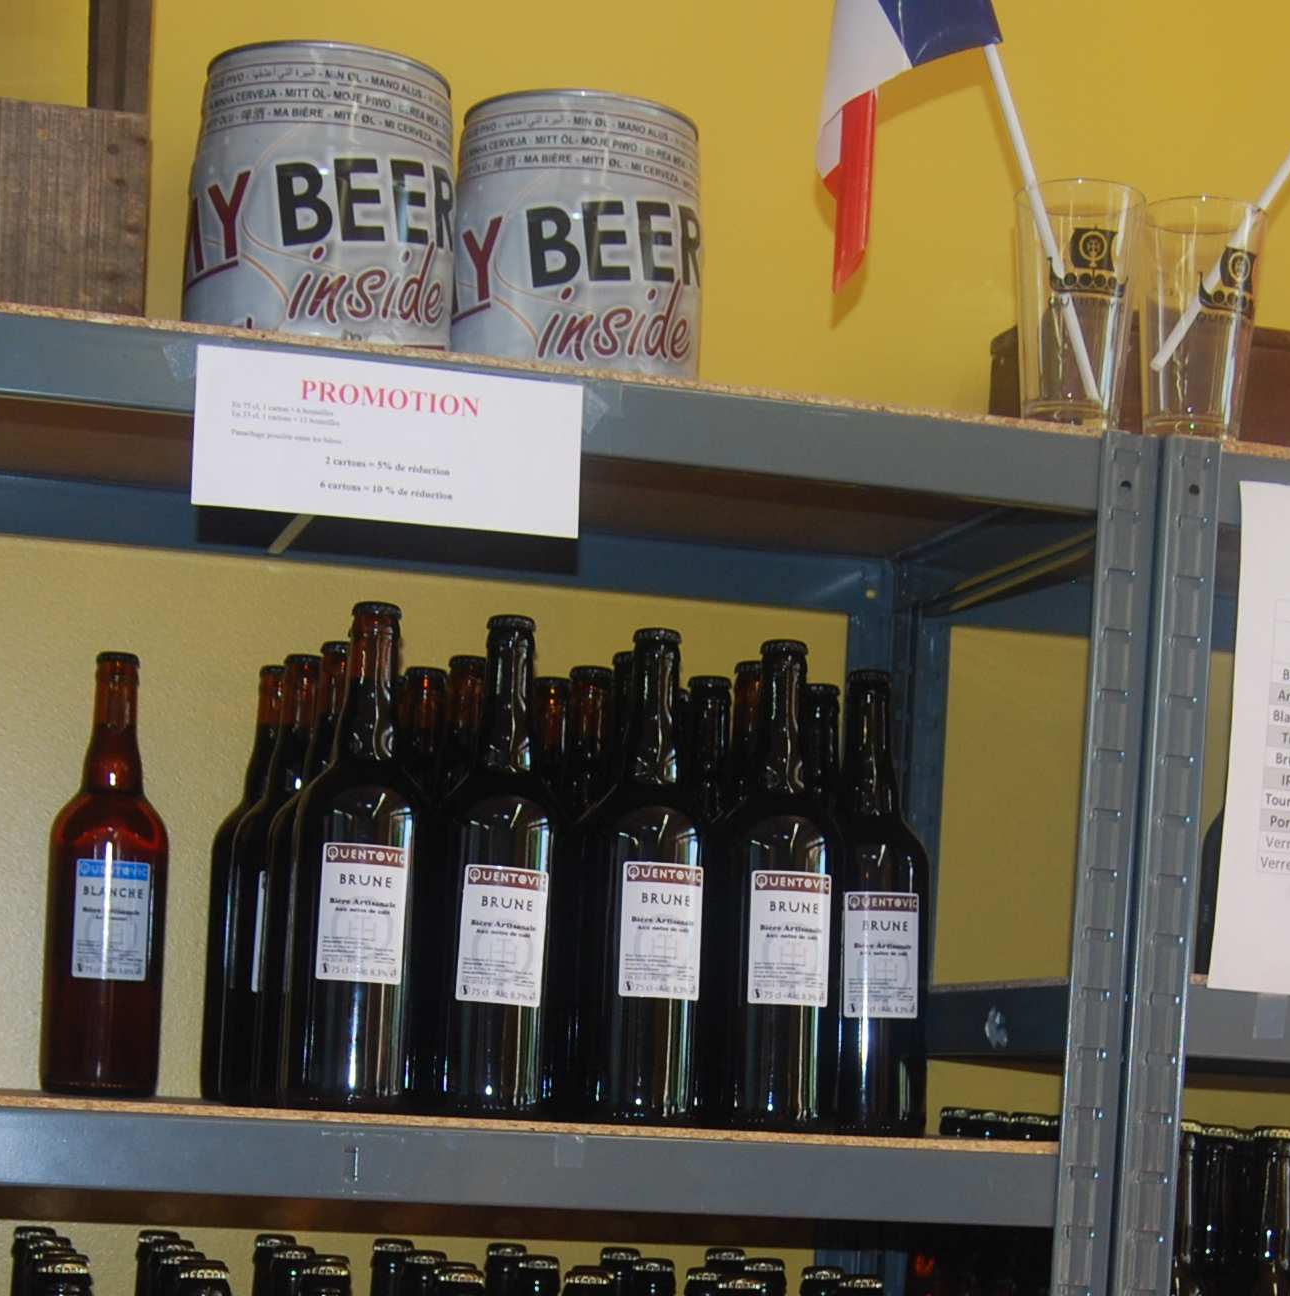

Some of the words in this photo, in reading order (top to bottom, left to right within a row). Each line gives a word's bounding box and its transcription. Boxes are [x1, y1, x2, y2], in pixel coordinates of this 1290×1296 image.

[524, 155, 539, 164] MA
[276, 158, 454, 251] BEER
[526, 200, 701, 288] BEER
[287, 242, 445, 324] inside
[537, 278, 690, 361] inside
[301, 380, 481, 417] PROMOTION
[325, 456, 331, 465] 2
[333, 458, 366, 469] cartons
[377, 461, 392, 471] 5%
[395, 463, 405, 472] de
[408, 463, 450, 476] réduction
[319, 480, 325, 489] 6
[327, 482, 361, 492] cartons
[372, 485, 383, 494] 10
[397, 488, 408, 497] de
[410, 488, 453, 501] réduction
[327, 846, 406, 864] QUENTOVIC
[339, 874, 392, 888] BRUNE
[627, 864, 702, 883] QUENTOVIC
[755, 875, 830, 891] QUENTOVIC
[481, 896, 533, 912] BRUNE
[641, 892, 691, 907] BRUNE
[769, 901, 819, 914] BRUNE
[861, 920, 909, 932] BRUNE
